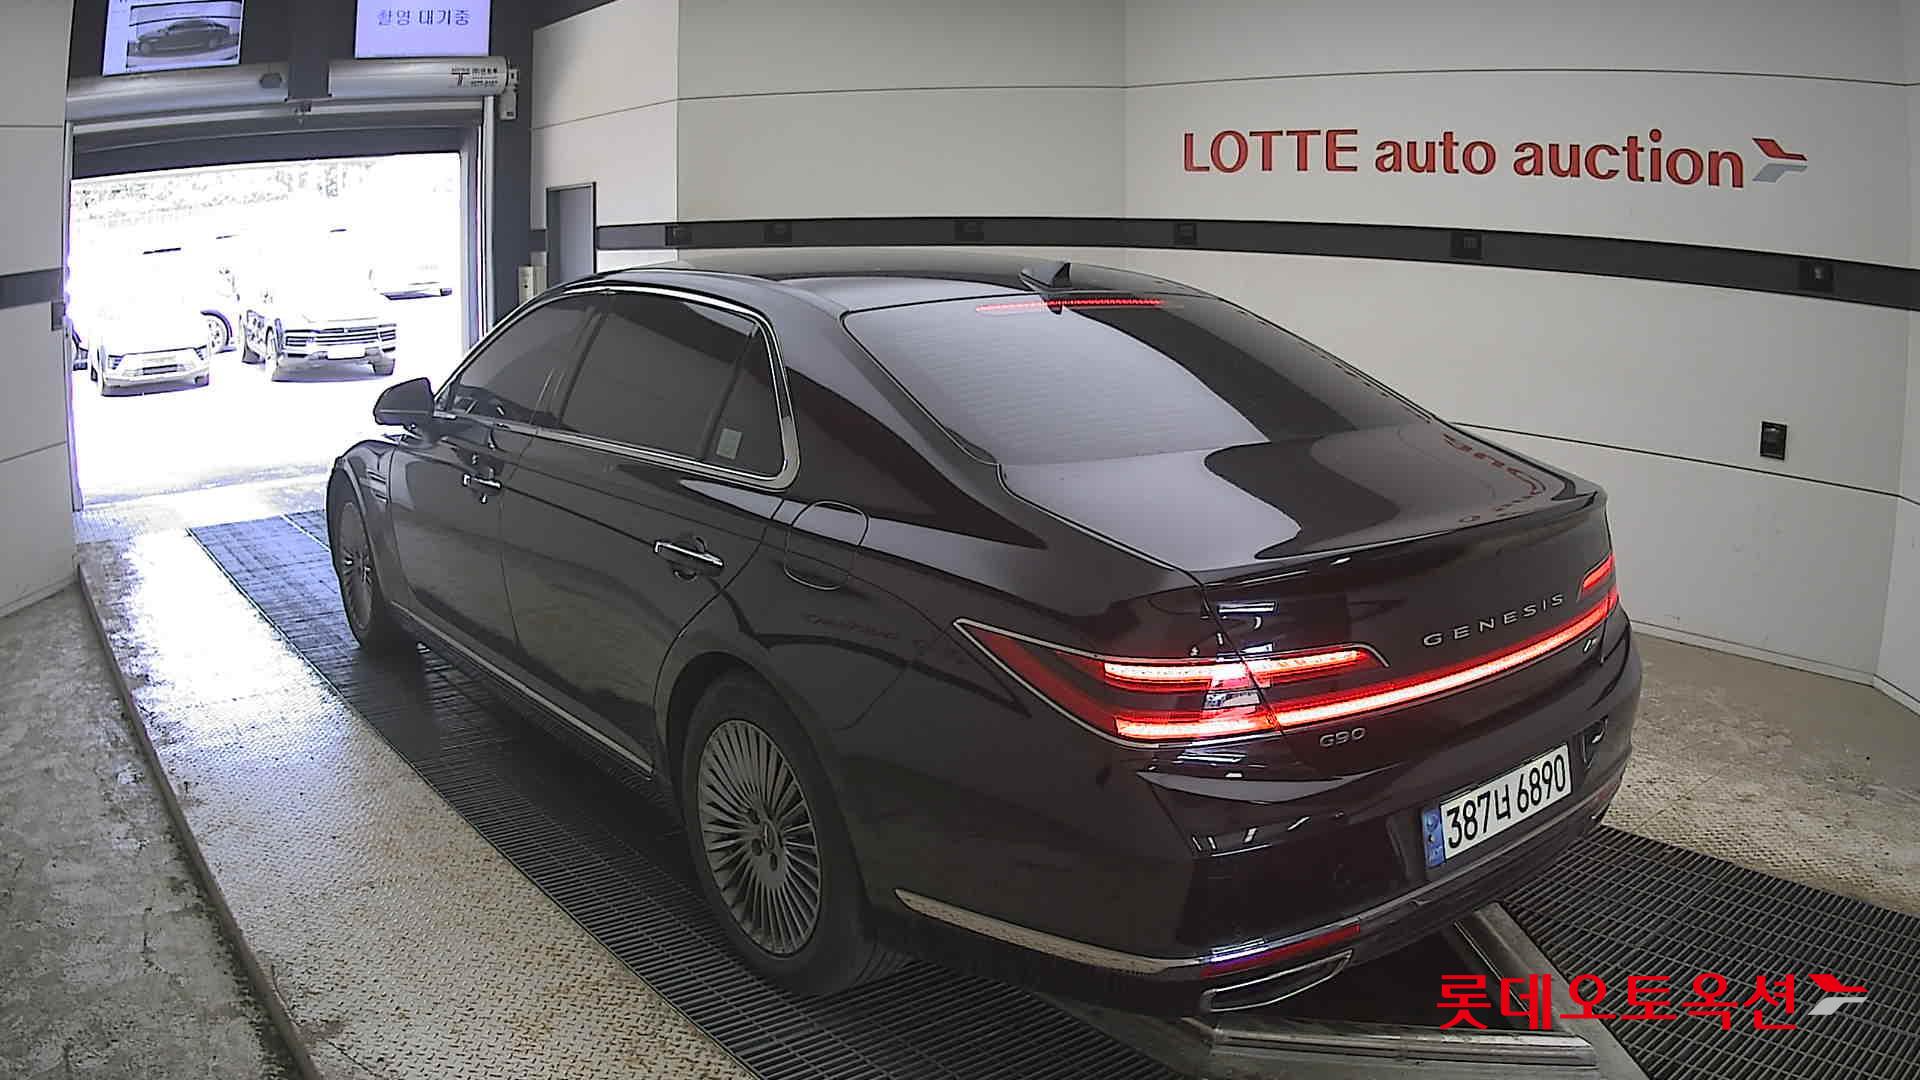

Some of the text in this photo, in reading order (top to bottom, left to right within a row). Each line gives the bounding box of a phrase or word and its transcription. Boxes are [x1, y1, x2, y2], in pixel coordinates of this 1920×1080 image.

[419, 8, 470, 26] 대기중
[1183, 127, 1745, 189] LOTTE auto auction
[1423, 592, 1564, 647] GENESIS
[1319, 727, 1366, 748] G90
[1446, 754, 1566, 849] 387너 6890
